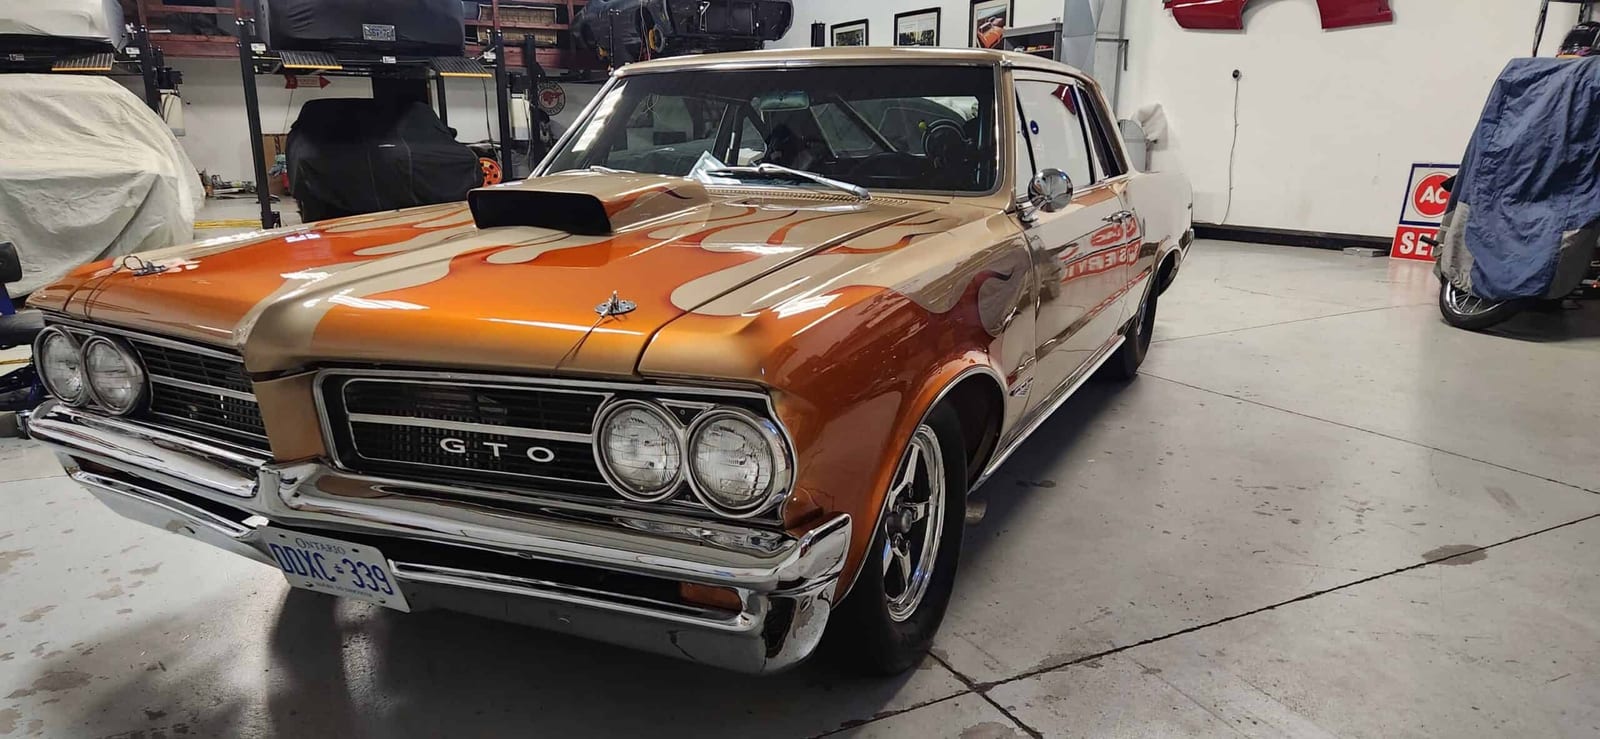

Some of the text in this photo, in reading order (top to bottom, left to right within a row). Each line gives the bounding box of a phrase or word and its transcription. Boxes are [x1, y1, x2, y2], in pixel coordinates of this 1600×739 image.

[1419, 185, 1447, 205] AC
[440, 438, 555, 462] GTO
[295, 537, 346, 555] ONTARIO
[268, 543, 336, 582] DDXC
[342, 558, 394, 595] 339
